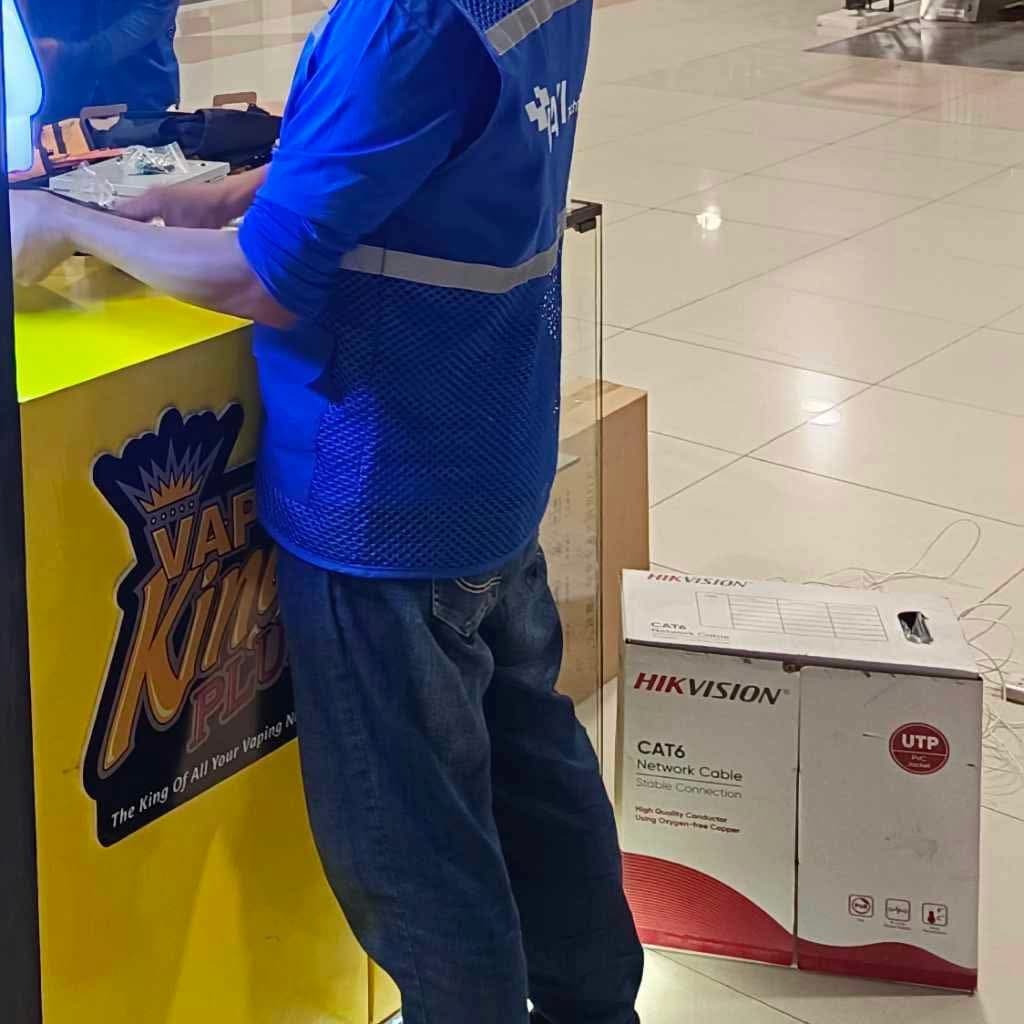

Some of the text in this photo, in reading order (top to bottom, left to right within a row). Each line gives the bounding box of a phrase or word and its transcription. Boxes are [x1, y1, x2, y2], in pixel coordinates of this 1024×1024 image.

[152, 487, 257, 580] VAP
[647, 573, 748, 588] HIKVISION
[185, 623, 287, 754] PLU
[633, 672, 782, 705] HIKVISION
[637, 740, 686, 758] CAT6
[901, 734, 939, 750] UTP
[111, 721, 282, 828] The King Of All Your Vaping
[636, 759, 743, 782] Network Cable
[636, 777, 742, 799] Stable Connection
